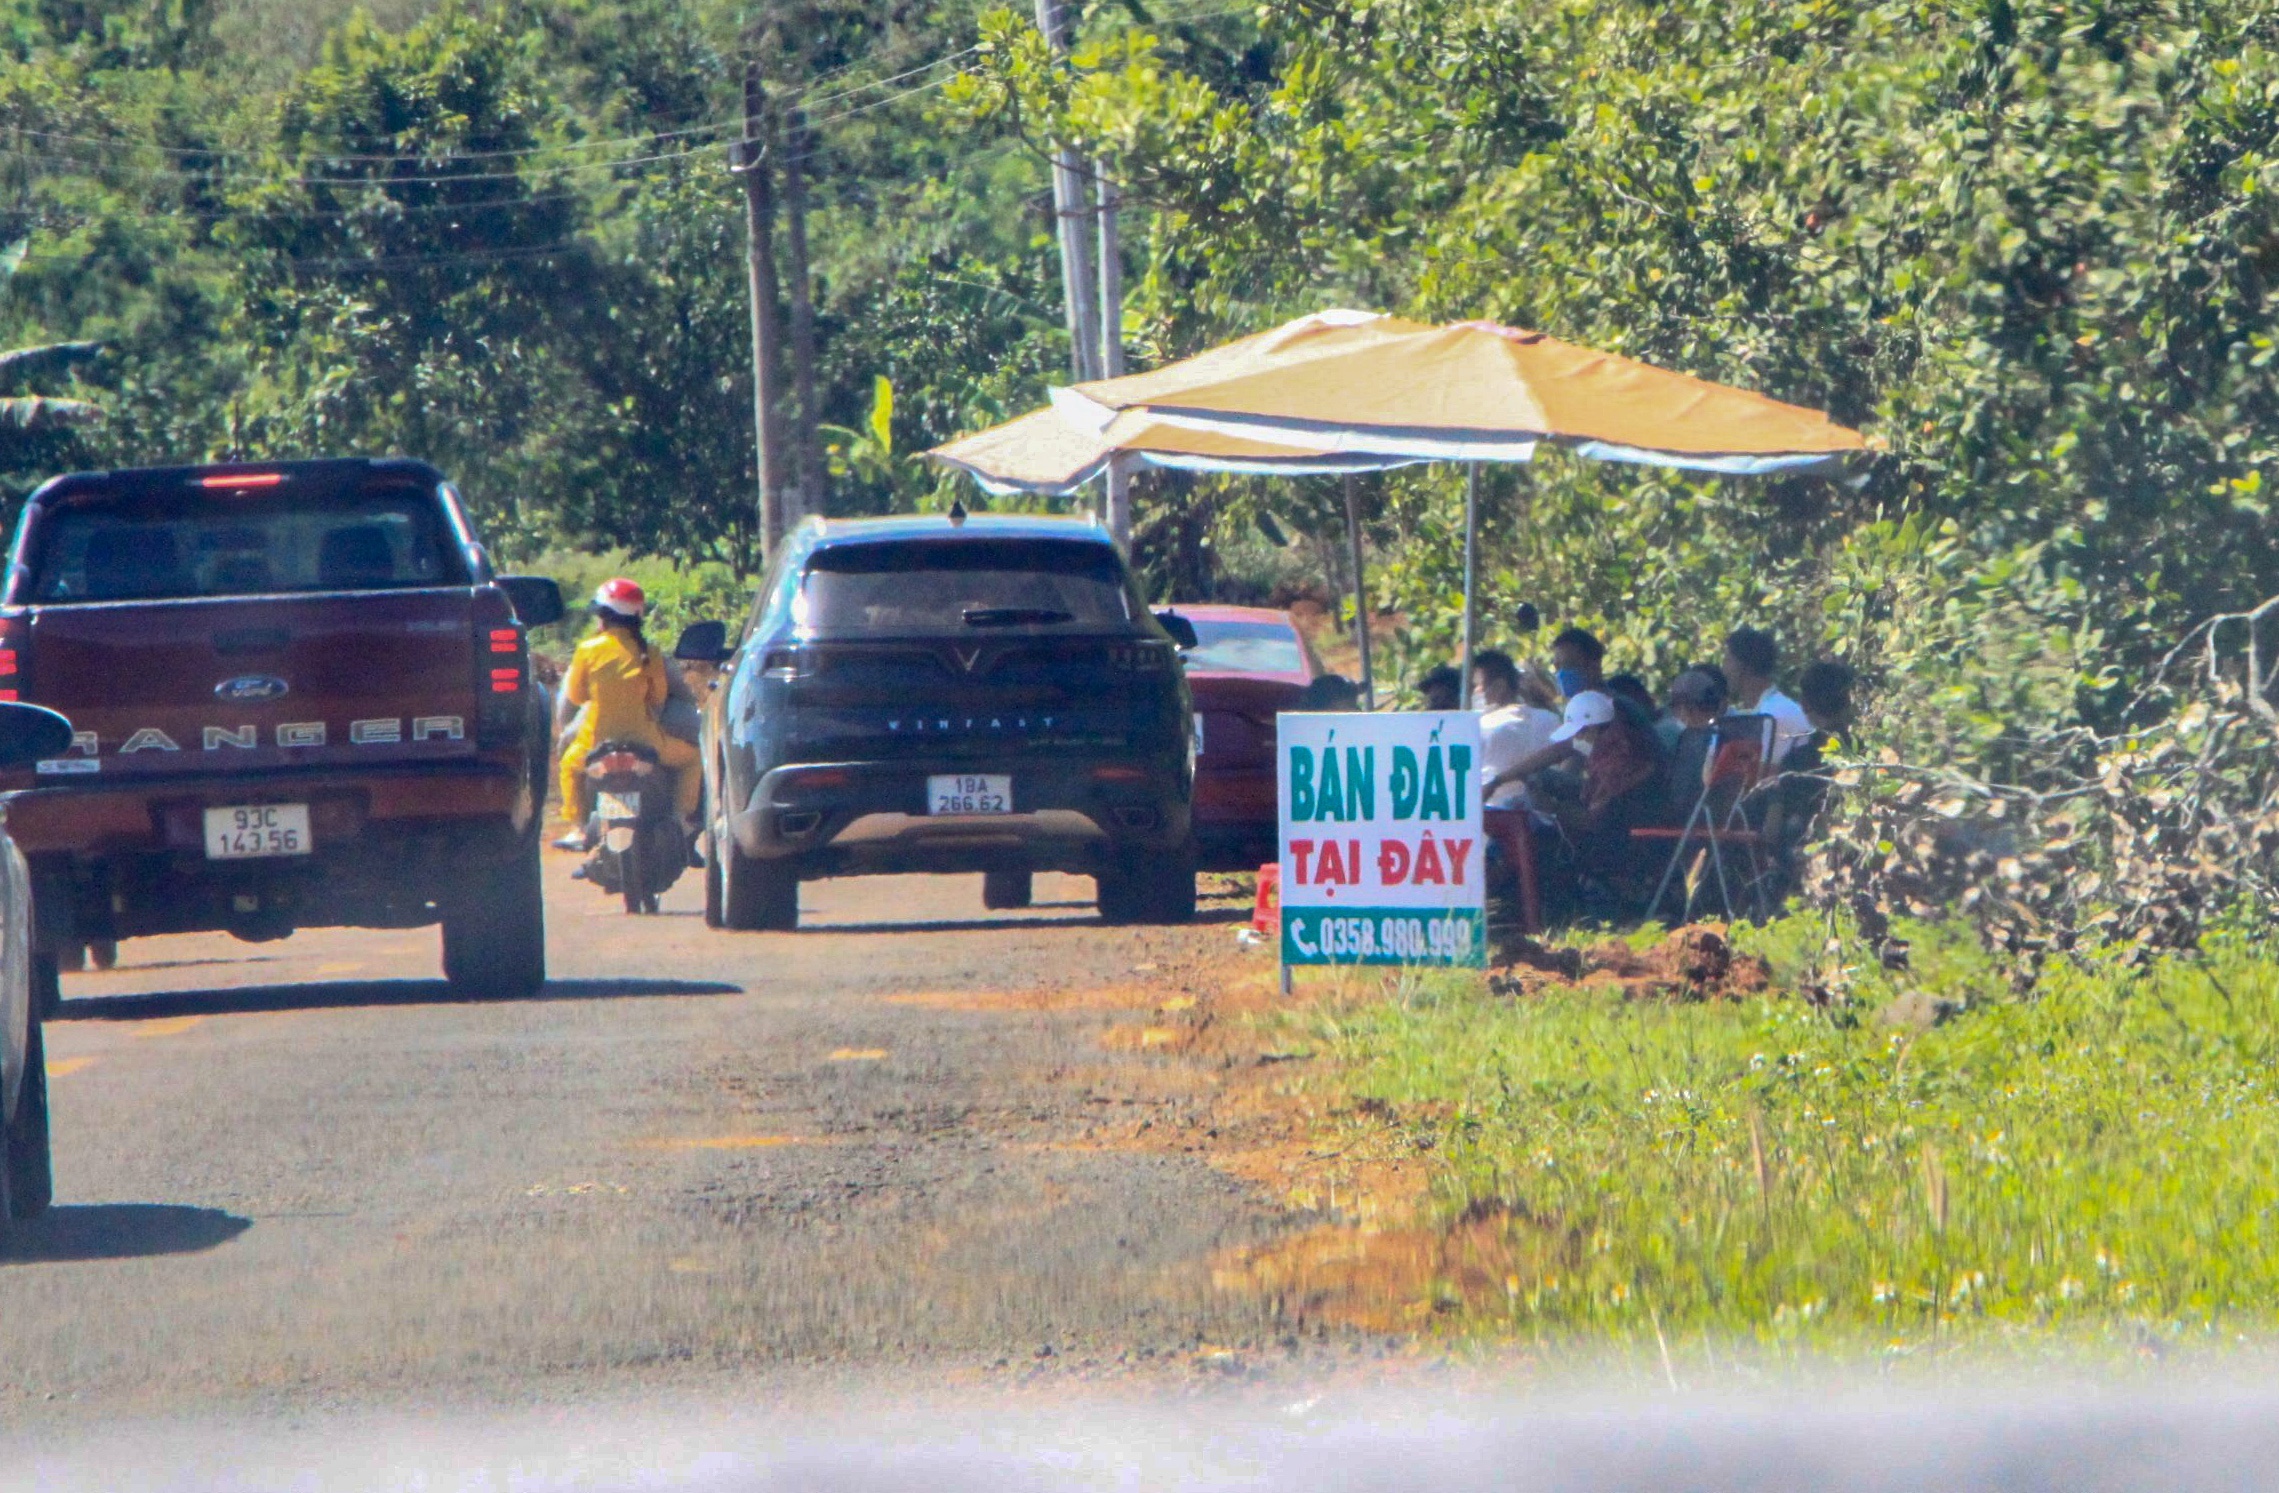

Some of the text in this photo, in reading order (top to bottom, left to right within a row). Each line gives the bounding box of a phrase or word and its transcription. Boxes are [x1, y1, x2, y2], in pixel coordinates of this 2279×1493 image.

[888, 717, 1054, 731] VINFAST
[1290, 729, 1375, 822] BÁN
[1389, 719, 1472, 821] ĐẤT
[234, 807, 278, 830] 93C
[219, 829, 298, 853] 143.56
[1289, 829, 1473, 898] TẠI ĐÂY
